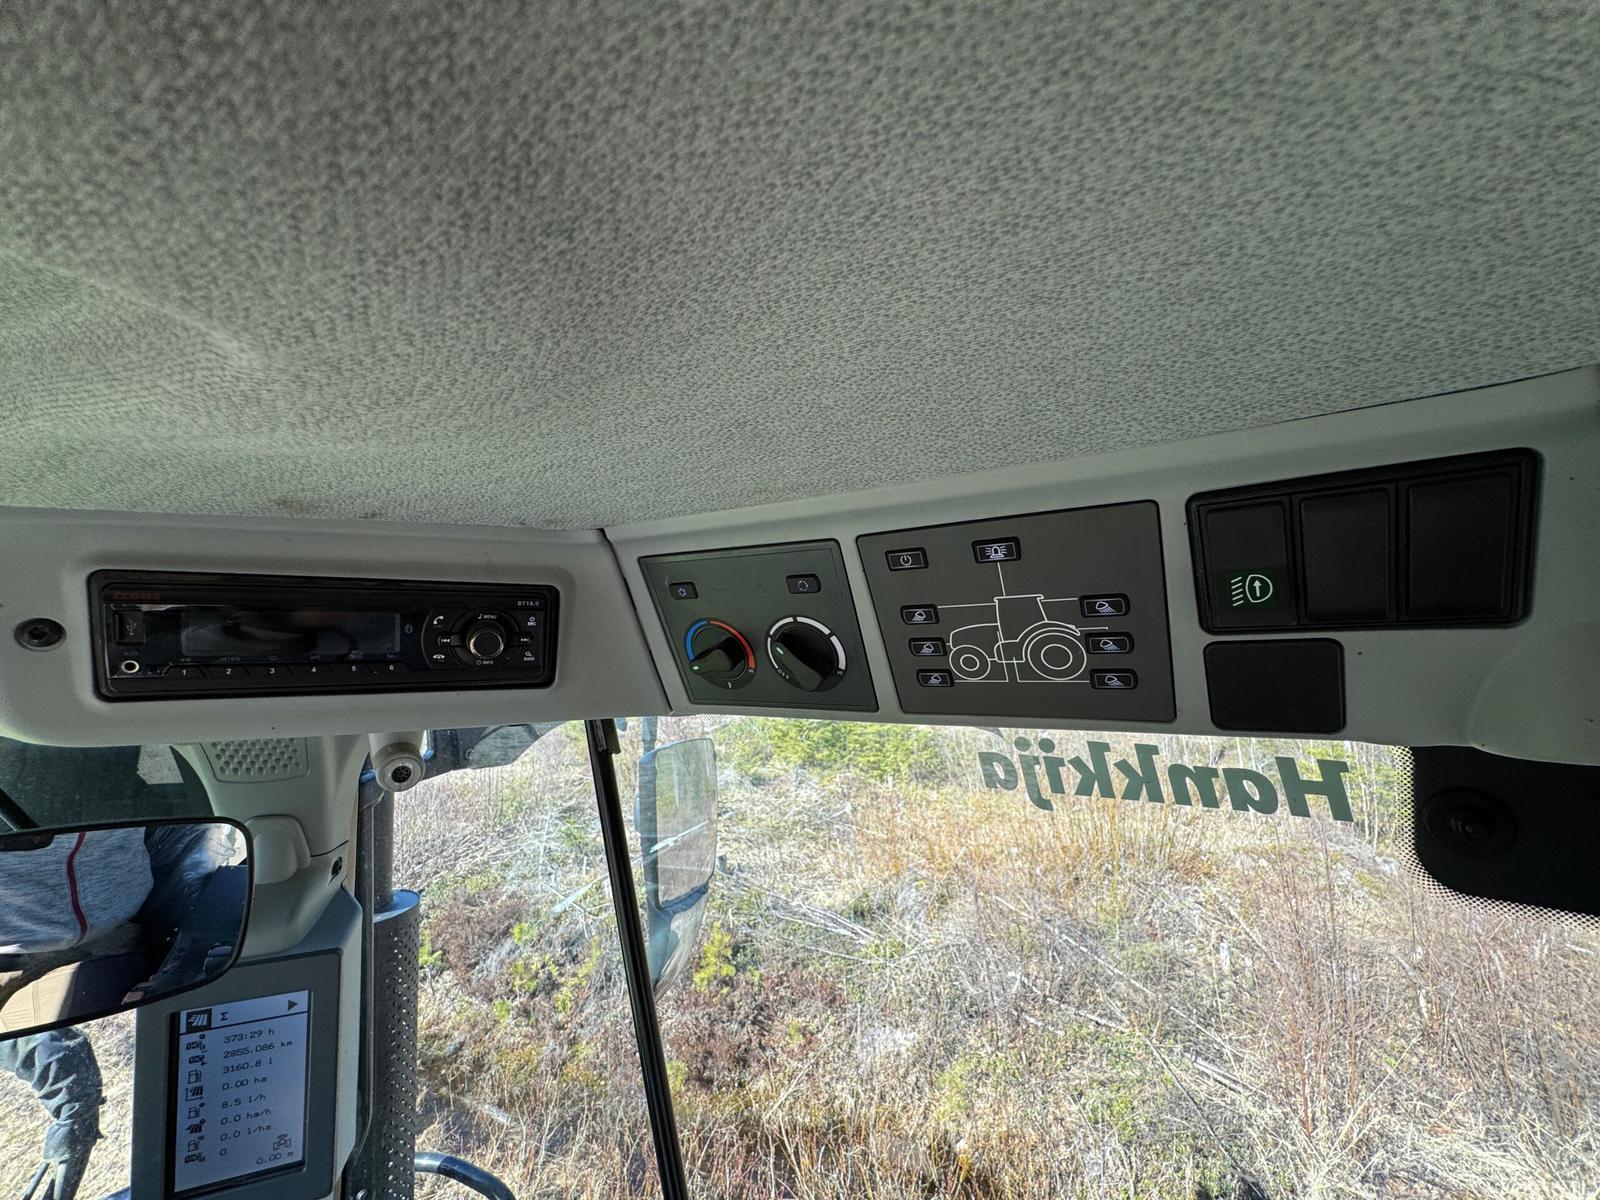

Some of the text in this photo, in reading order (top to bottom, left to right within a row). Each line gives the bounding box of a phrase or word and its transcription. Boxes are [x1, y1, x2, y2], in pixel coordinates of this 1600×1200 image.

[224, 1030, 262, 1044] 373:29
[223, 1040, 293, 1058] 2855.086 km
[223, 1060, 261, 1074] 3160.8
[222, 1079, 248, 1090] 0.00
[222, 1098, 242, 1109] 8.5
[221, 1108, 271, 1125] 0.0 ha/h
[220, 1131, 240, 1141] 0.0
[220, 1148, 227, 1156] 0
[256, 1153, 282, 1165] 0.00
